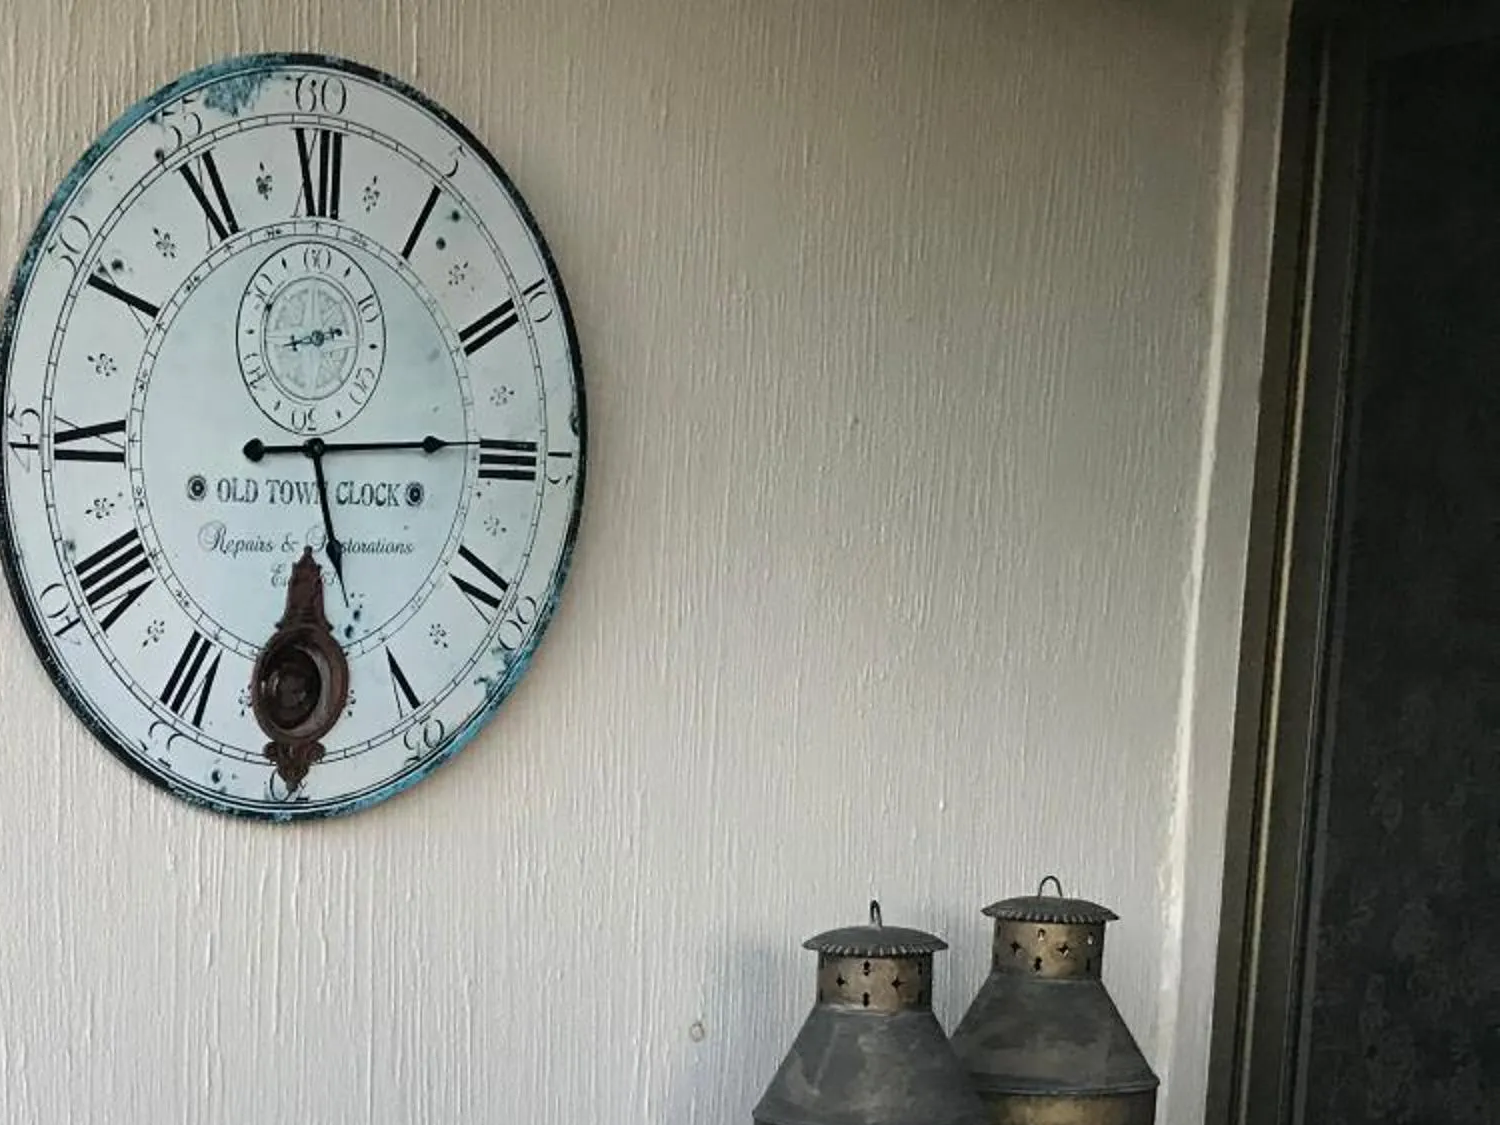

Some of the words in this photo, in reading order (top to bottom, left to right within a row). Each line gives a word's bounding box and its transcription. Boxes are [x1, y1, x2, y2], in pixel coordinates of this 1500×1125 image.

[295, 74, 347, 115] 60
[171, 147, 243, 253] XI
[291, 126, 349, 221] XII
[84, 256, 163, 338] X
[457, 297, 521, 359] II
[522, 277, 554, 323] 10
[7, 402, 42, 474] 45
[53, 406, 128, 469] IX
[477, 437, 539, 482] III
[217, 478, 258, 504] OLD
[336, 481, 402, 508] CLOCK
[198, 521, 274, 559] Repairs
[281, 531, 300, 553] &
[306, 524, 414, 554] Rstorations
[39, 583, 84, 646] 40
[159, 628, 225, 731] VII
[383, 645, 422, 720] V
